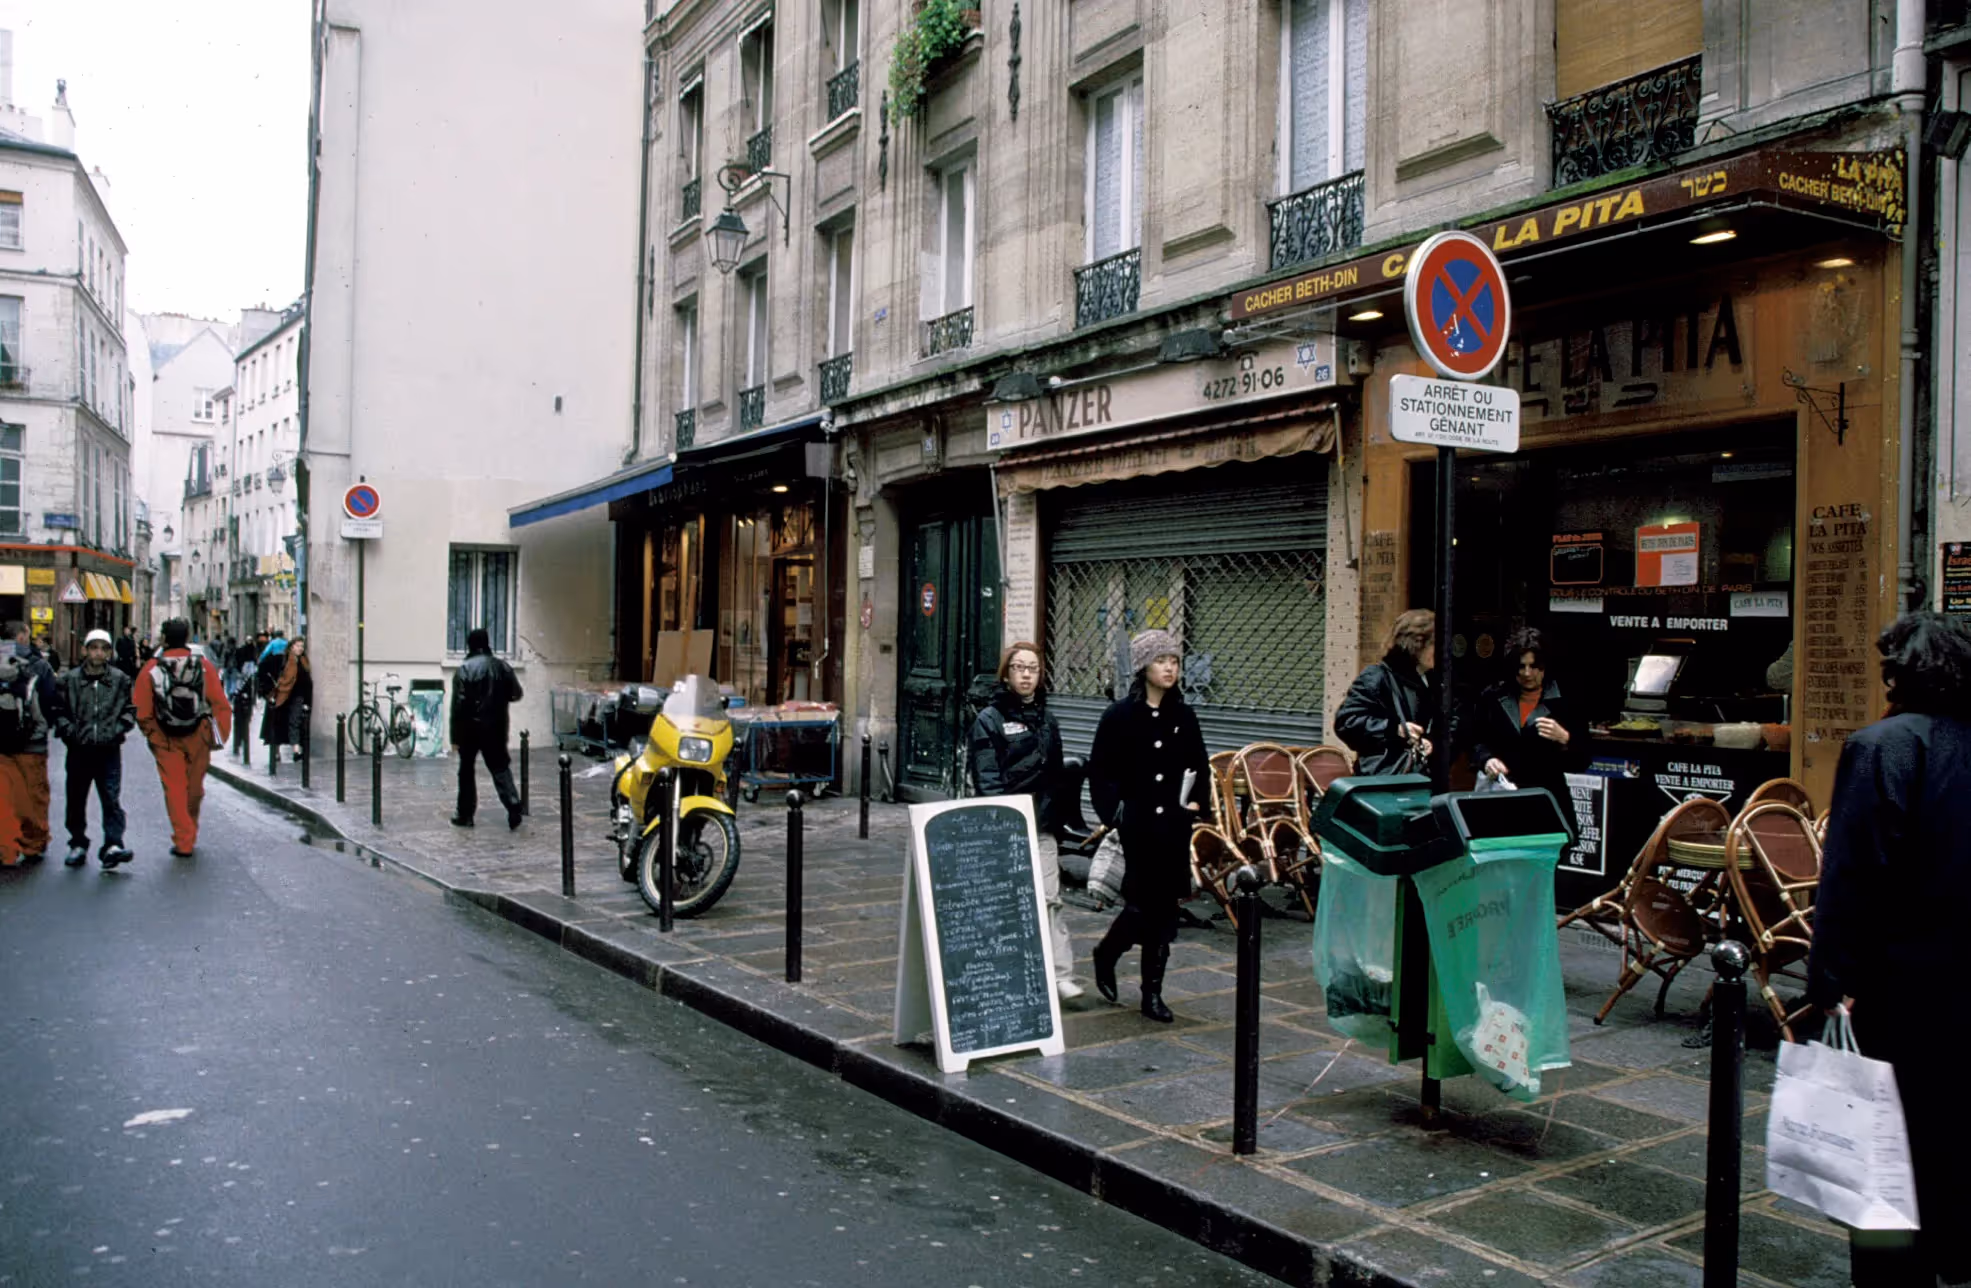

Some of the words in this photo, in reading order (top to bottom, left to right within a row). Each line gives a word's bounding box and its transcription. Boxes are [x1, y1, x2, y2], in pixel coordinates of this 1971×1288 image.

[1681, 170, 1727, 198] כשר
[1779, 171, 1829, 199] CACHER
[1493, 216, 1540, 250] LA
[1552, 189, 1645, 236] PITA
[1245, 286, 1293, 312] CACHER
[1296, 267, 1358, 299] BETH-DIN
[1424, 384, 1468, 402] ARRÊT
[1473, 390, 1492, 405] OU
[1019, 384, 1113, 438] PANZER
[1400, 398, 1513, 423] STATIONNEMENT
[1430, 416, 1485, 436] GÊNANT
[1813, 503, 1862, 519] CAFE
[1809, 524, 1828, 538] LA
[1834, 521, 1867, 537] PITA
[1702, 585, 1716, 593] DE
[1721, 584, 1752, 593] PARIS
[1610, 615, 1648, 628] VENTE
[1651, 616, 1660, 628] A
[1667, 617, 1728, 630] EMPORTER
[1668, 762, 1689, 774] CAFE
[1690, 764, 1701, 774] LA
[1703, 765, 1722, 776] PITA
[1655, 774, 1681, 786] VENTE
[1682, 776, 1689, 786] A
[1691, 776, 1735, 791] EMPORTER
